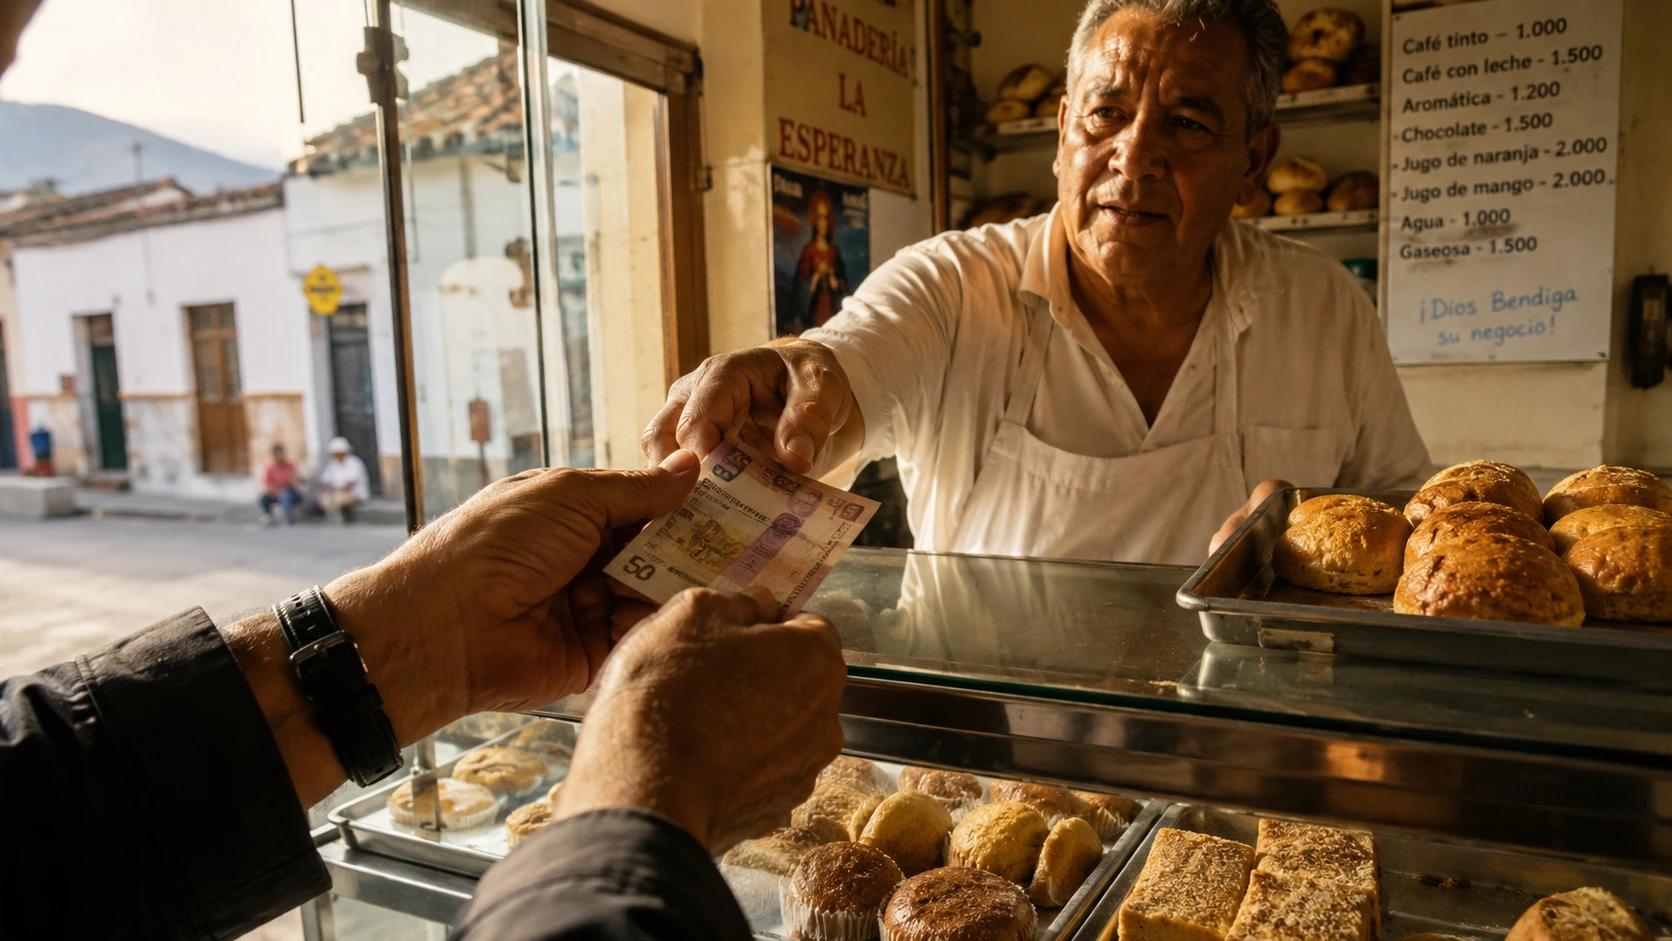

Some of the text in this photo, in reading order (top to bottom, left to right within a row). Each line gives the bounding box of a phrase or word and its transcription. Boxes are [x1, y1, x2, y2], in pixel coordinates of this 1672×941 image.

[1403, 36, 1441, 54] Café
[1448, 32, 1488, 48] tinto
[1517, 18, 1567, 39] 1.000
[1403, 66, 1441, 83] Café
[1447, 64, 1478, 78] con
[1485, 55, 1532, 73] leche
[1552, 45, 1602, 65] 1.500
[838, 72, 867, 117] LA
[1403, 92, 1491, 112] Aromática
[1512, 81, 1560, 101] 1.200
[1402, 123, 1487, 142] Chocolate
[1505, 113, 1553, 131] 1.500
[777, 117, 910, 188] ESPERANZA
[1403, 158, 1441, 174] Jugo
[1447, 152, 1468, 167] de
[1474, 146, 1538, 164] naranja
[1555, 138, 1607, 157] 2.000
[1403, 187, 1441, 202] Jugo
[1447, 182, 1467, 197] de
[1474, 179, 1534, 195] mango
[1553, 169, 1605, 188] 2.000
[1402, 217, 1443, 233] Agua
[1464, 209, 1511, 226] 1.000
[1400, 245, 1470, 260] Gaseosa
[1491, 237, 1538, 254] 1.500
[1420, 287, 1577, 323] ¡Dios Bendiga
[1438, 316, 1555, 346] su negocio!
[622, 555, 656, 581] 50
